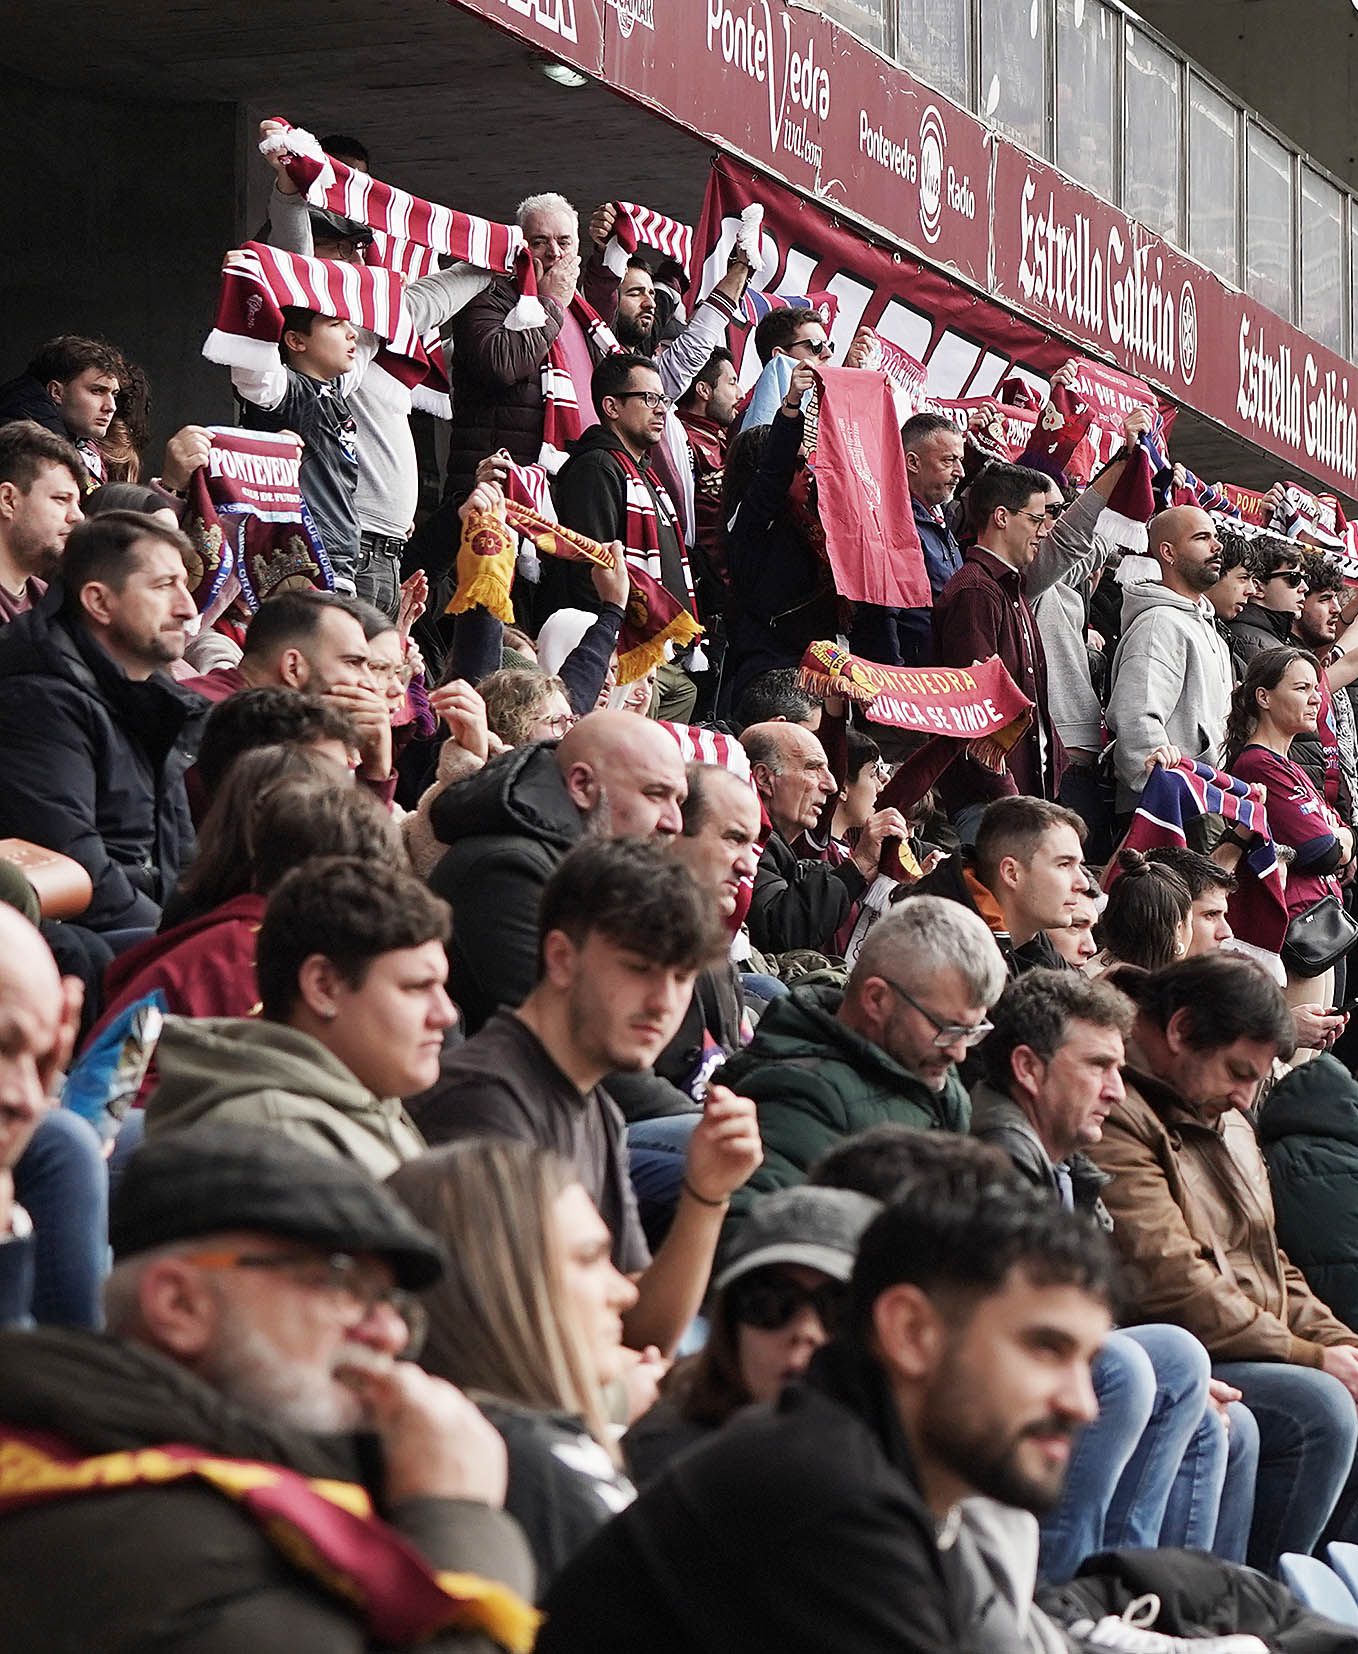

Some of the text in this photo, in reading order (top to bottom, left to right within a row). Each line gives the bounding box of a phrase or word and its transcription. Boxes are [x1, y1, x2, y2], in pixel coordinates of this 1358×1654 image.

[859, 110, 917, 184] Pontevedra
[947, 166, 975, 220] Radio
[1018, 174, 1103, 336] Estrella
[1107, 226, 1175, 375] Galicia
[1236, 313, 1357, 481] Estrella Galicia
[869, 695, 1004, 733] NUNCA SE RINDE
